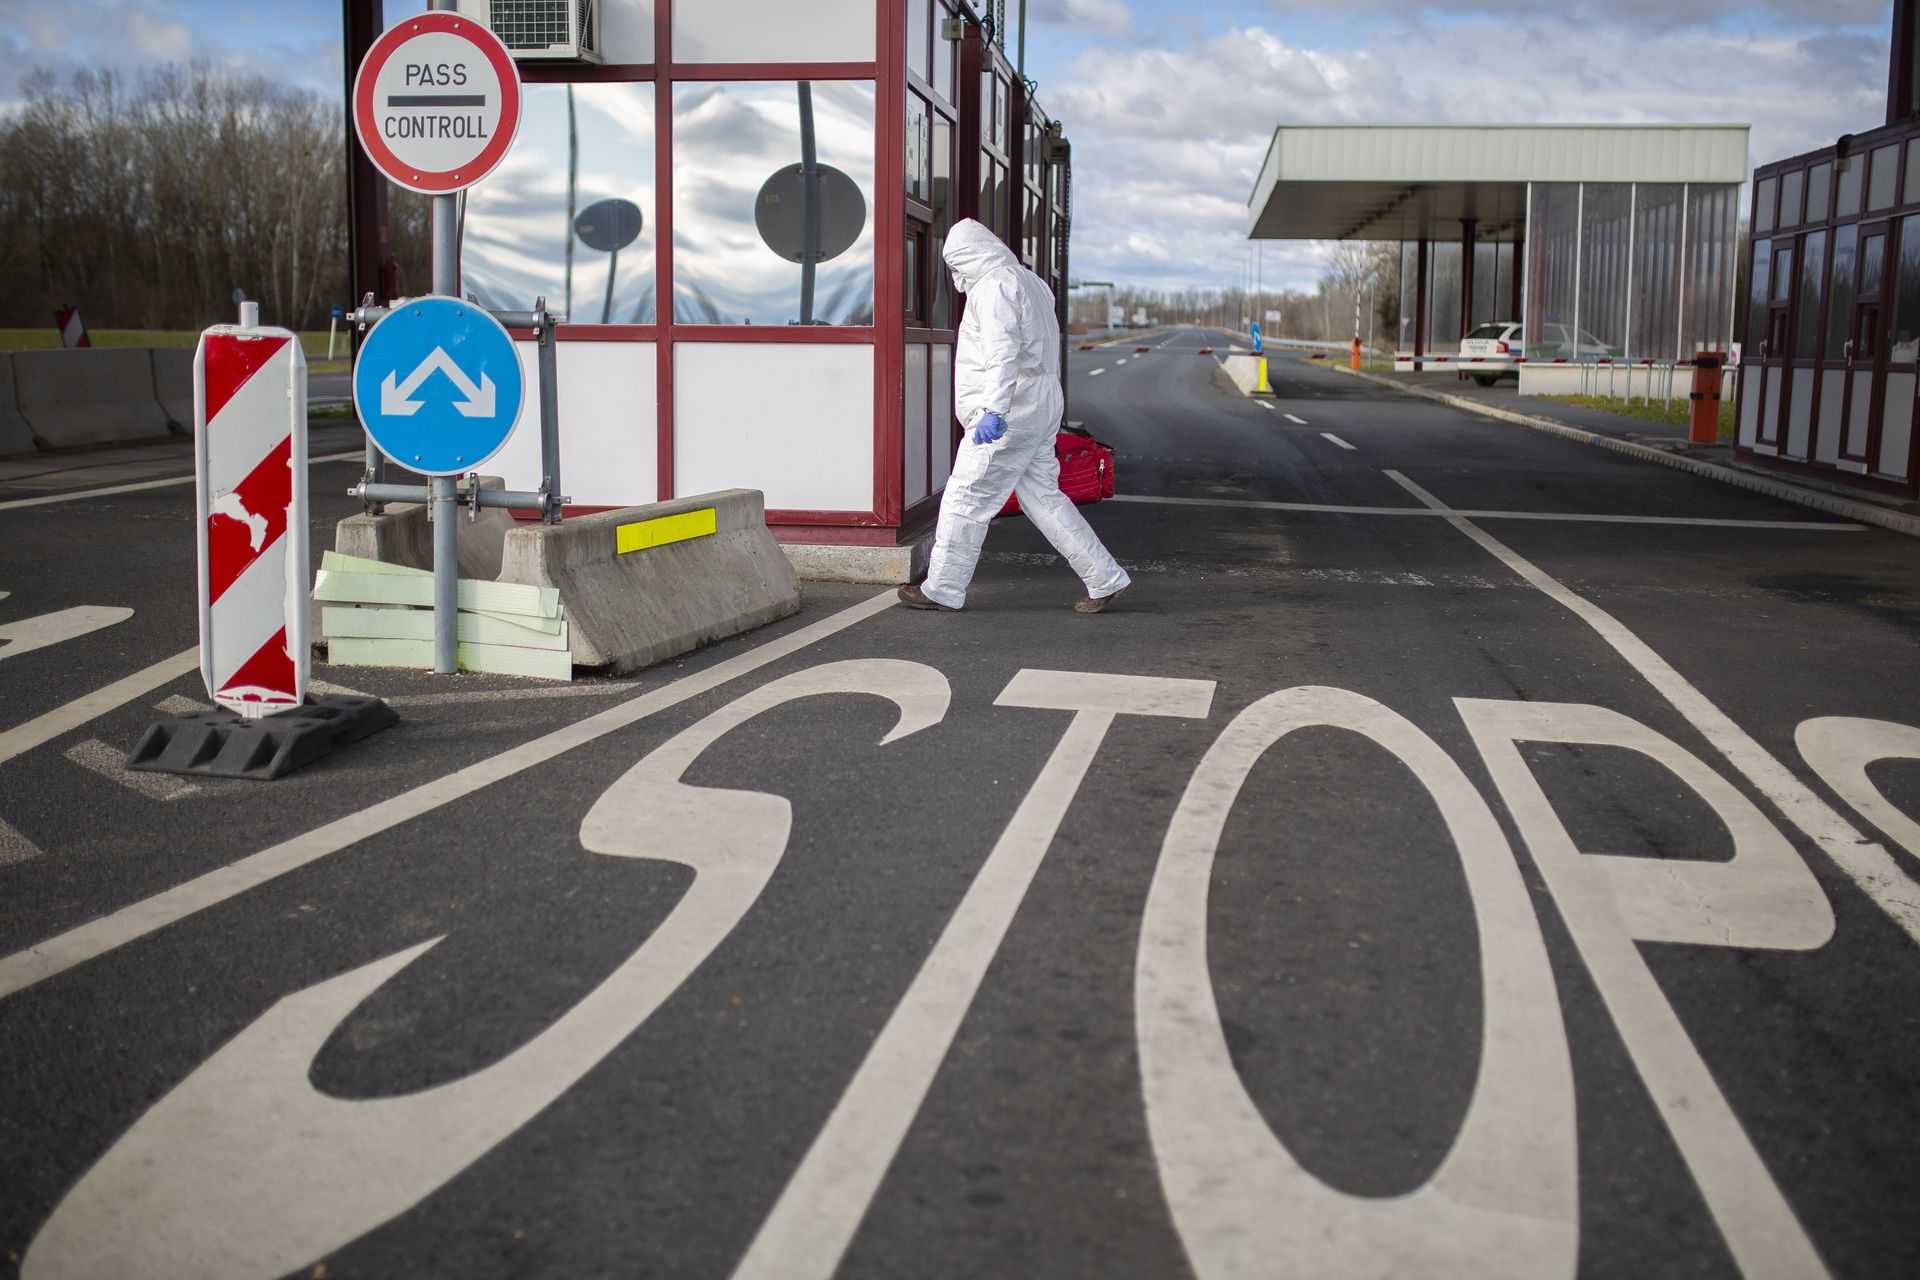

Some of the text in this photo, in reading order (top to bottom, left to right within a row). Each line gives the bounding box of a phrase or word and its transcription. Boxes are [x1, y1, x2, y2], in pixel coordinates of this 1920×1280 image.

[405, 63, 467, 86] PASS
[384, 115, 487, 138] CONTROLL
[20, 658, 1836, 1280] STOP
